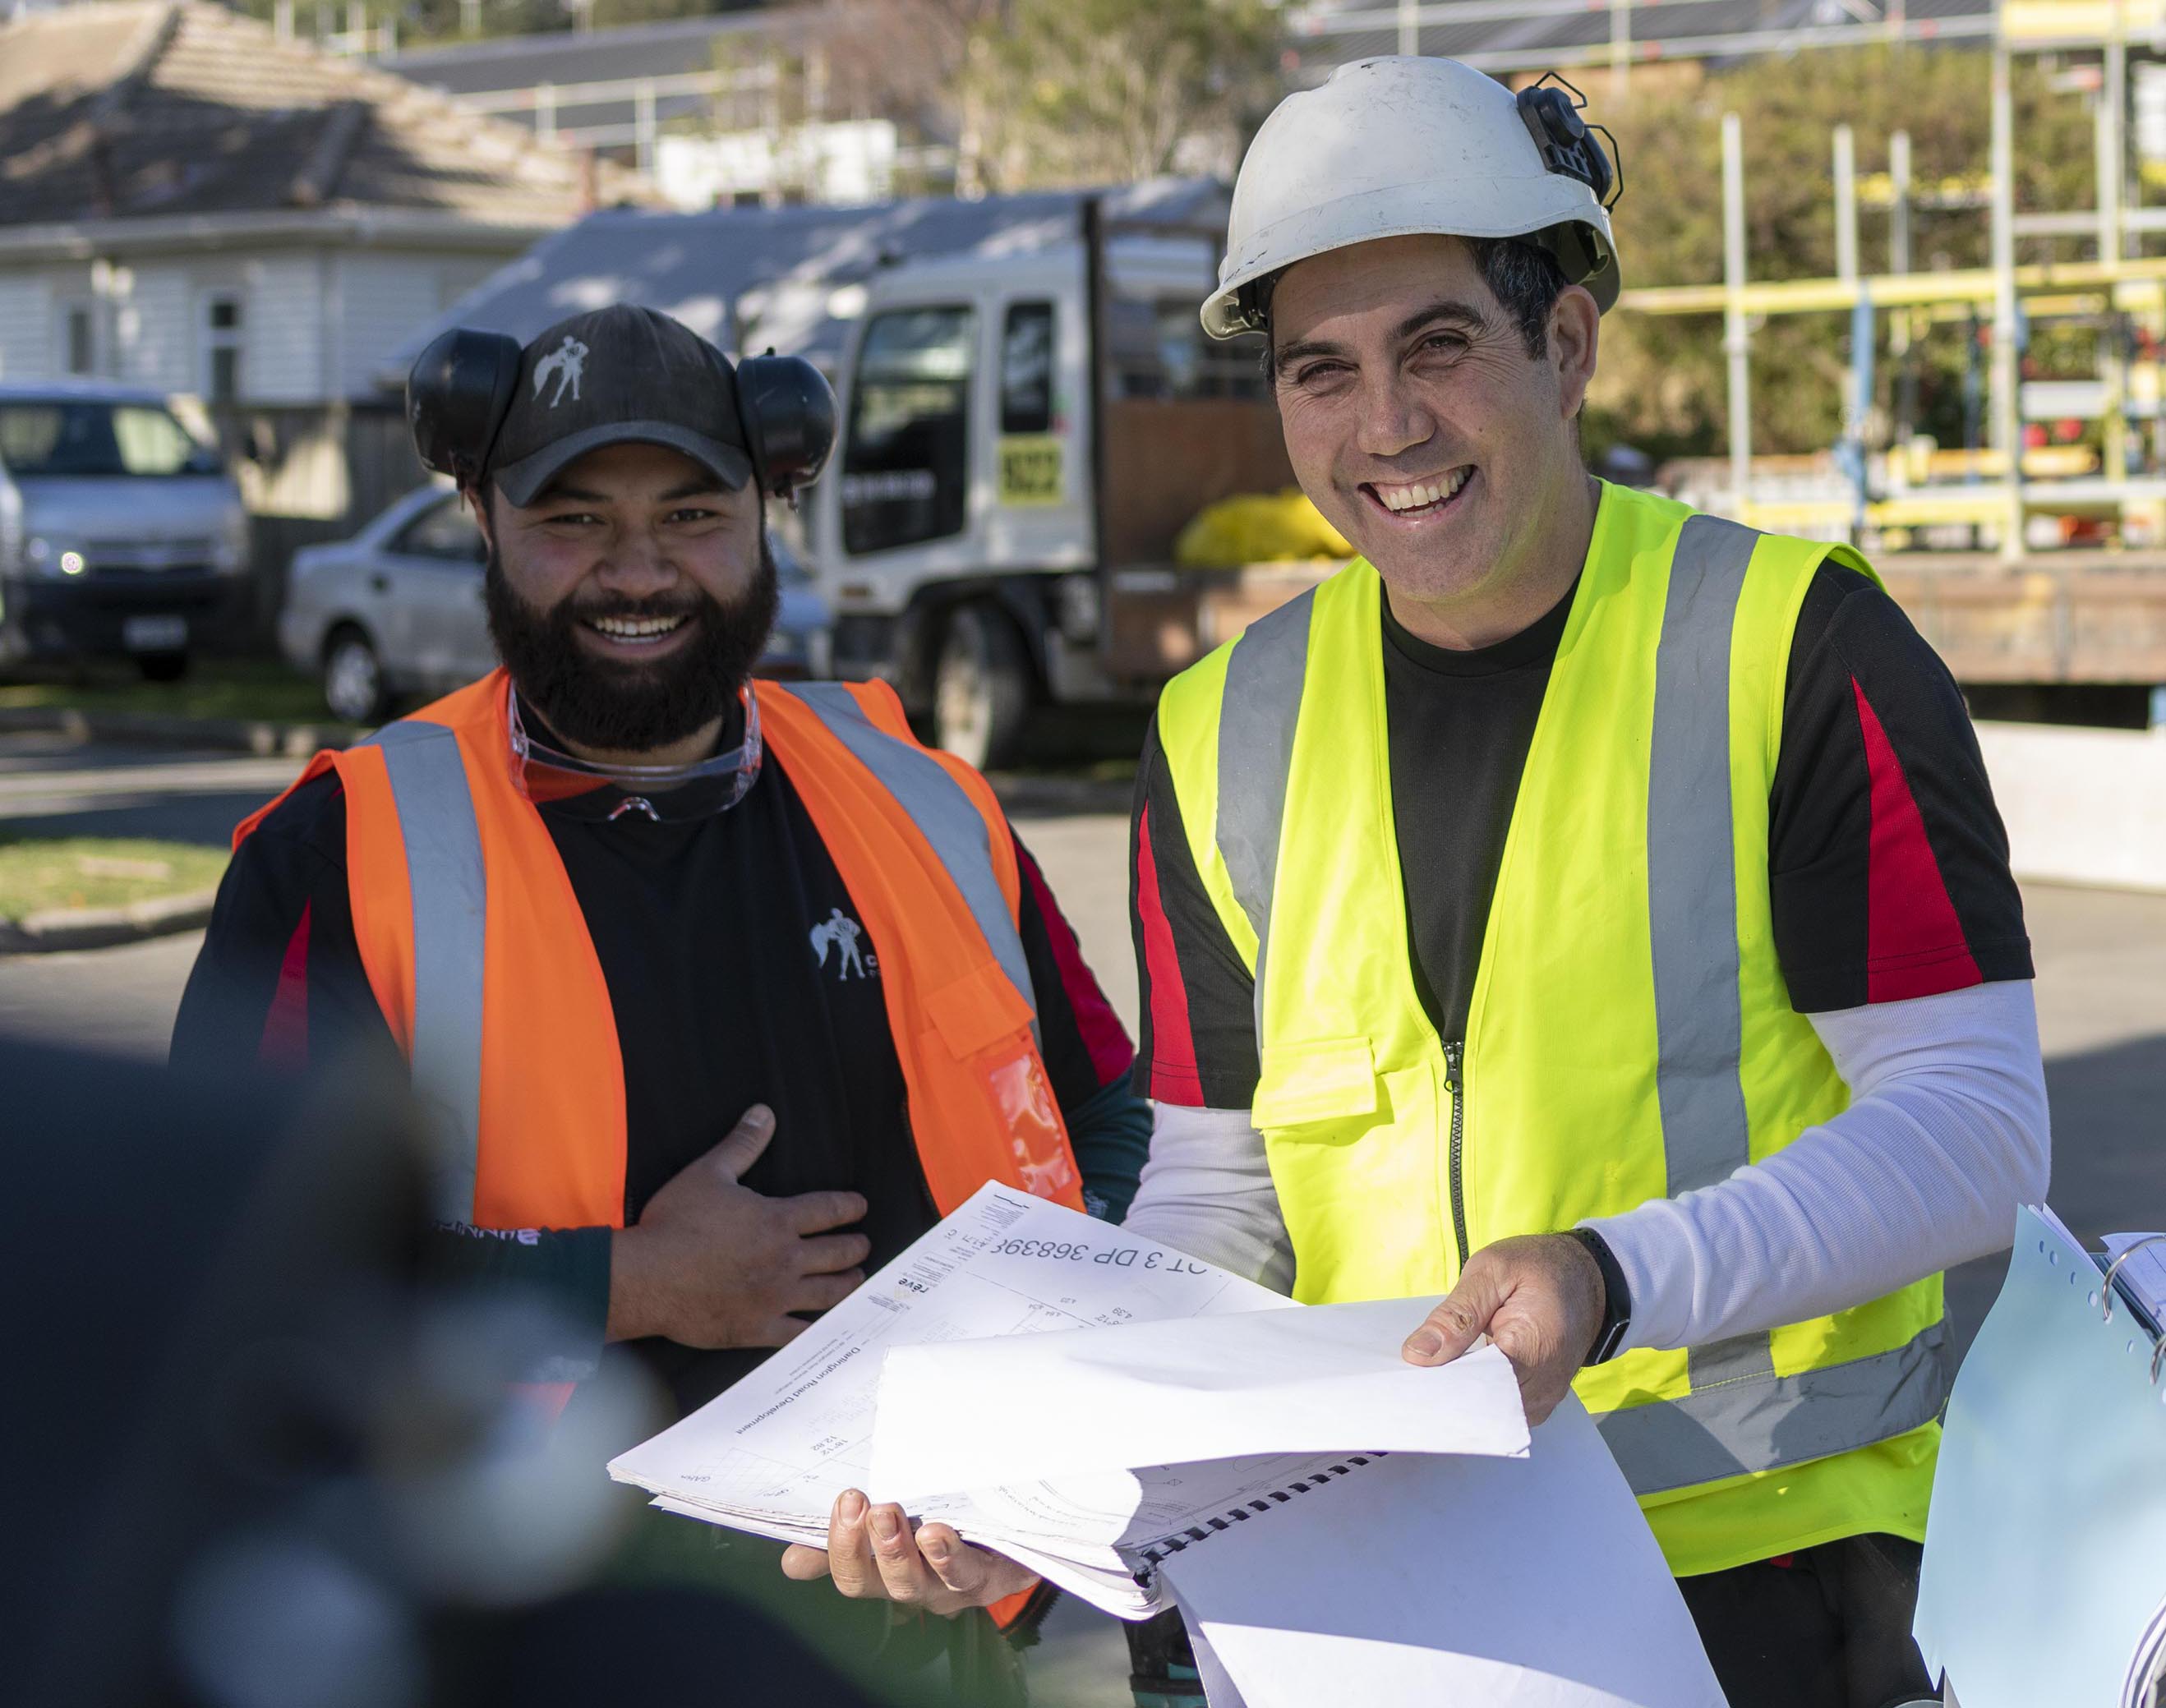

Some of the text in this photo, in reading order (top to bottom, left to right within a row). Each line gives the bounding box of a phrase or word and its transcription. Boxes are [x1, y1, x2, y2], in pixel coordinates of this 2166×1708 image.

[1094, 1248, 1139, 1267] DP
[1144, 1251, 1164, 1269] 3
[818, 1347, 860, 1380] Darlington
[793, 1379, 818, 1397] Road
[735, 1396, 795, 1434] Development
